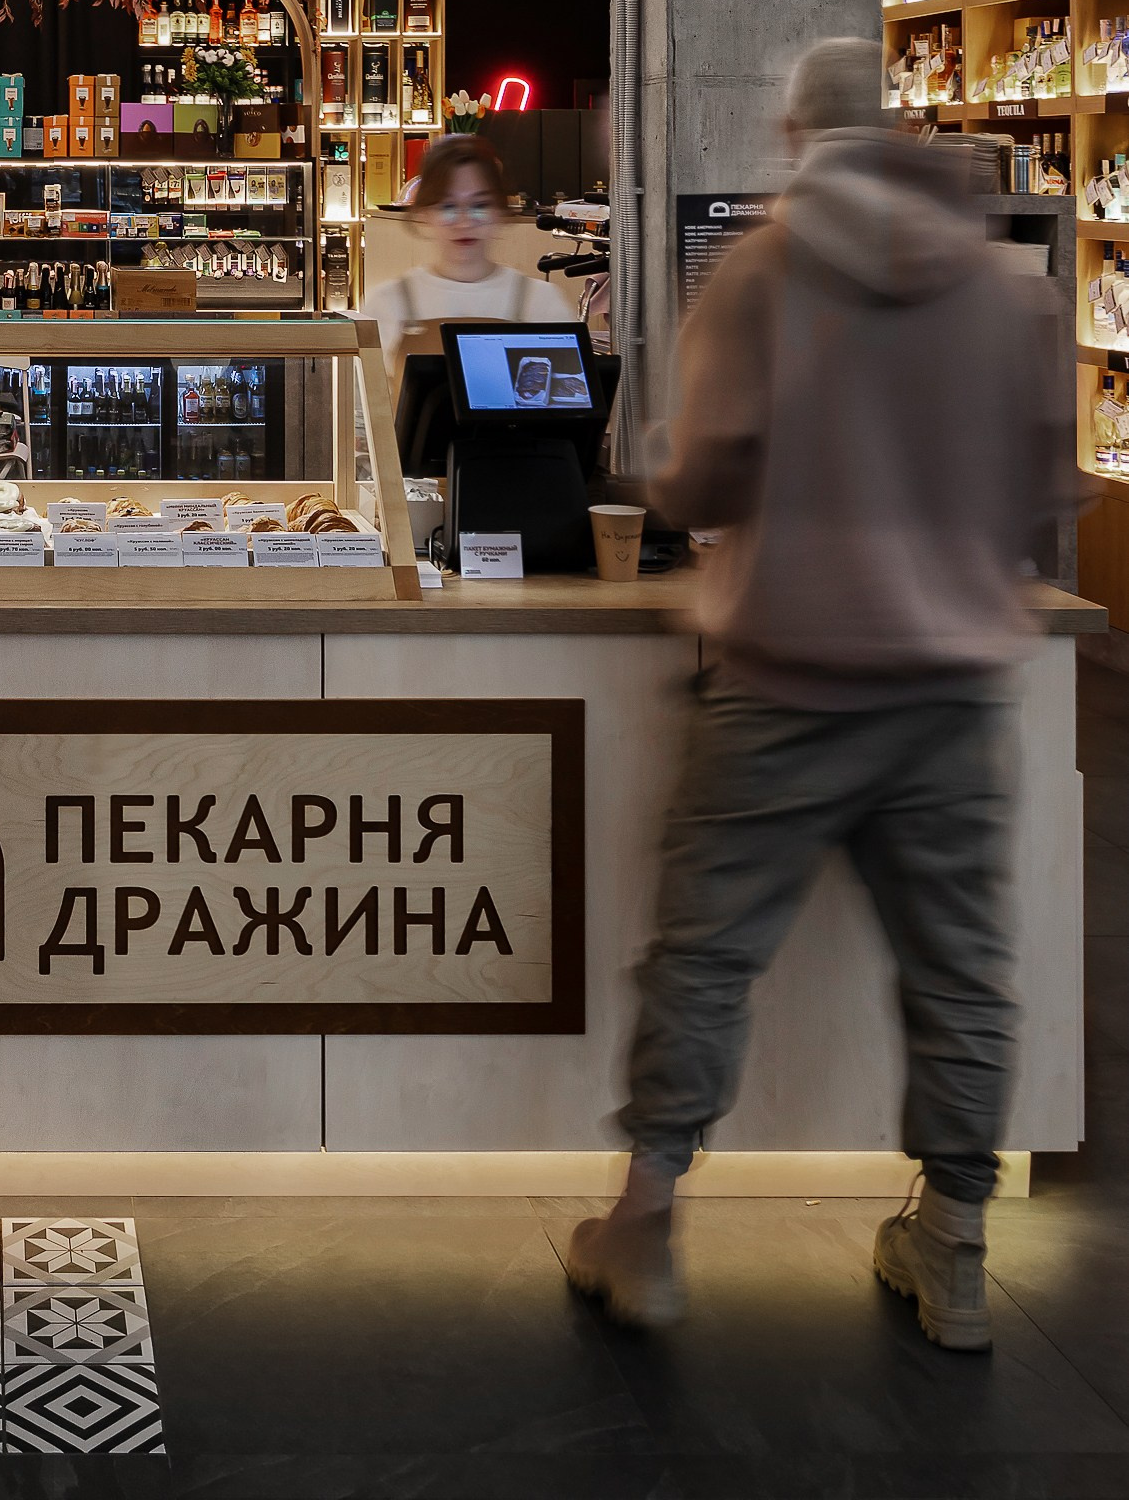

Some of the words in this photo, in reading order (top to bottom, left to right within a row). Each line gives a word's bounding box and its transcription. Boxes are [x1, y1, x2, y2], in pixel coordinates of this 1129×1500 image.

[996, 104, 1025, 116] TEQUILA
[45, 794, 464, 863] ПЕКАРНЯ
[38, 885, 514, 976] ДРАЖИНА
